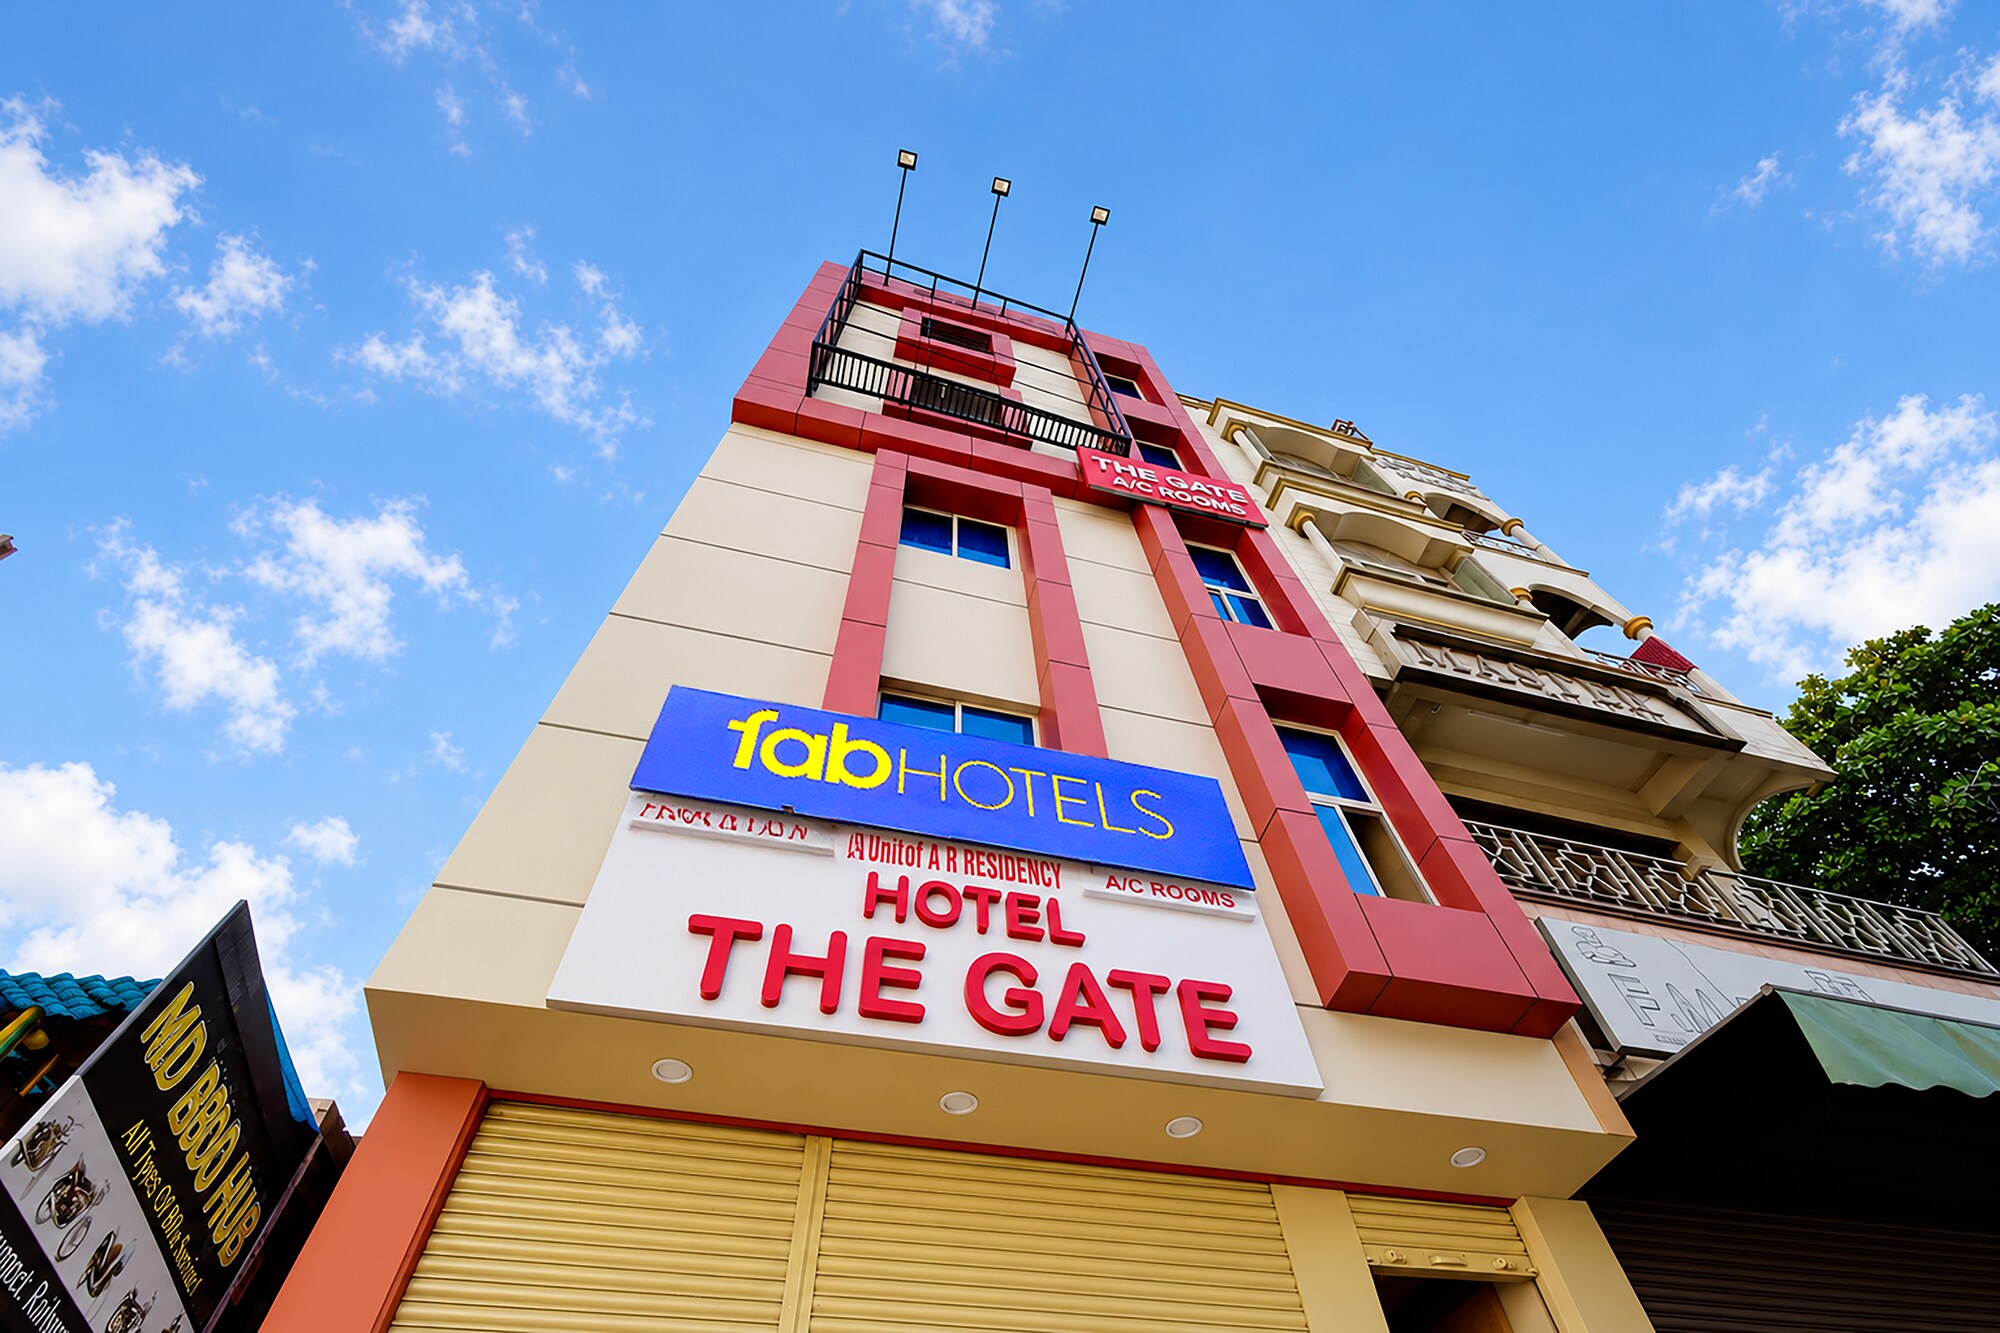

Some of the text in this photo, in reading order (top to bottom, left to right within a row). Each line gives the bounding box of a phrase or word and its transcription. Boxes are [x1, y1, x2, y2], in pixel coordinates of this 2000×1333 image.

[1091, 455, 1249, 504] THE GATE
[1113, 476, 1247, 516] A/C ROOMS
[928, 842, 941, 871] A
[945, 845, 958, 874] R
[963, 847, 1062, 890] RESIDENCY
[863, 871, 1087, 949] HOTEL
[1105, 874, 1236, 909] A/C ROOMS
[687, 913, 1254, 1064] THE GATE
[121, 1119, 151, 1156] All
[202, 1151, 261, 1268] HUB
